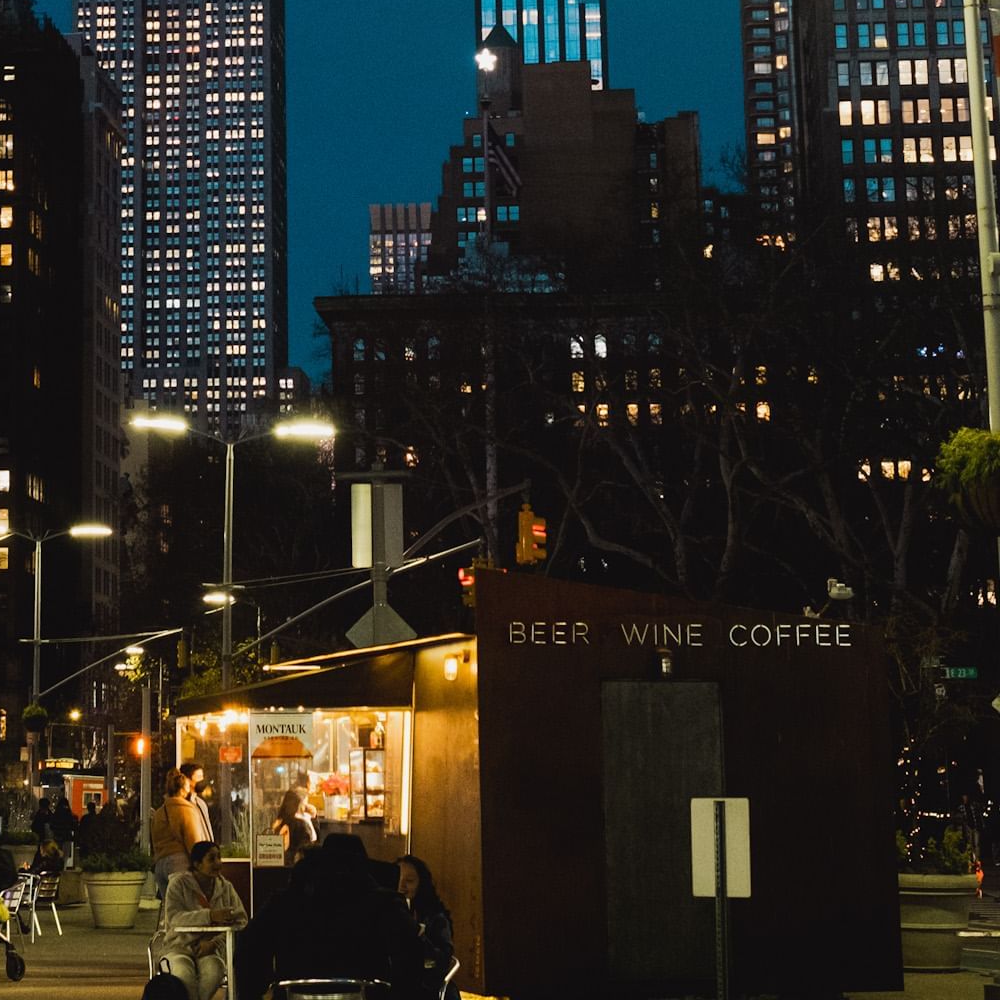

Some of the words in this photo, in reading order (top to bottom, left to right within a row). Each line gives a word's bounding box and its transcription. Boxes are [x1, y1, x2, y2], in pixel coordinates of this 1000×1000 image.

[509, 621, 590, 645] BEER
[620, 623, 703, 647] WINE
[729, 623, 852, 647] COFFEE
[256, 723, 306, 734] MONTAUK
